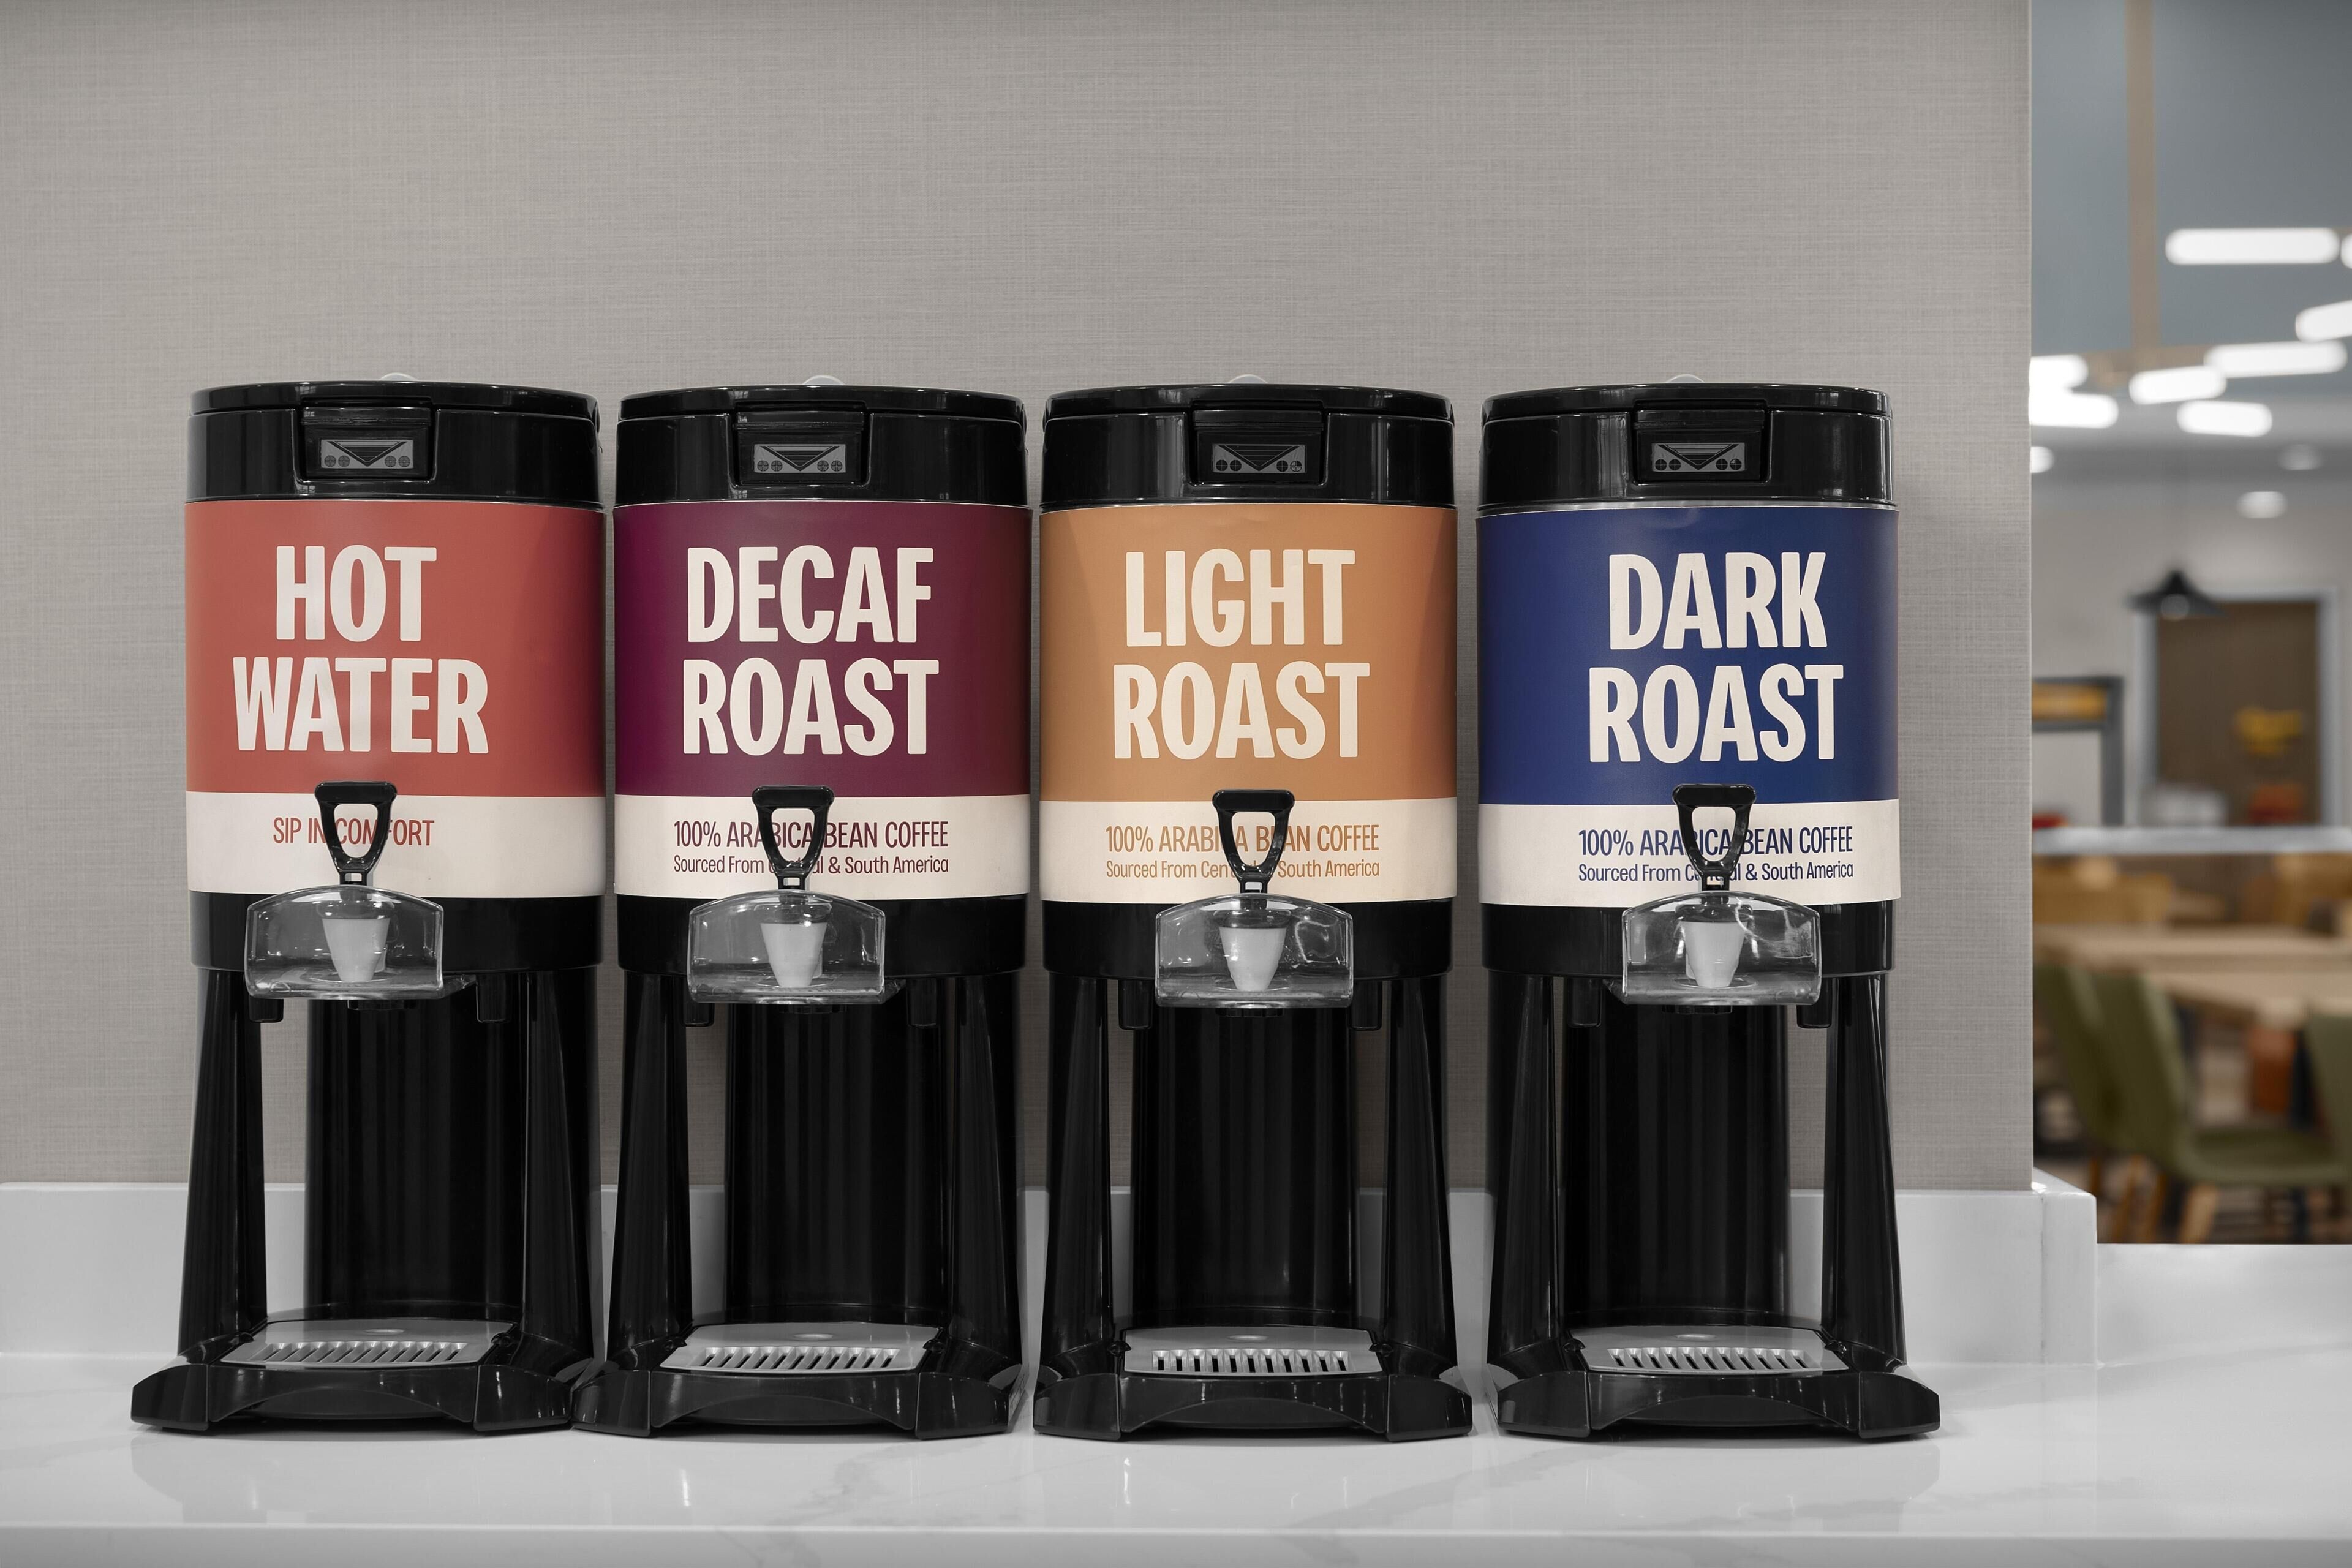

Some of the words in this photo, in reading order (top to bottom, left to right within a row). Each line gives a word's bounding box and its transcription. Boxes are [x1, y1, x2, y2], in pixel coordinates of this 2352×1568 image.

[276, 545, 437, 642] HOT
[687, 545, 933, 644] DECAF
[1126, 548, 1355, 647] LIGHT
[1609, 552, 1828, 649] DARK
[233, 657, 489, 753] WATER
[683, 657, 940, 756] ROAST
[1114, 661, 1370, 760] ROAST
[1589, 663, 1844, 763] ROAST
[273, 817, 302, 843] SIP
[335, 818, 435, 846] COMORT
[674, 821, 721, 847] 100%
[824, 821, 878, 848] BEAN
[885, 821, 949, 848] COFFEE
[674, 854, 725, 873] Sourced
[729, 856, 764, 873] From
[828, 856, 841, 874] &
[845, 856, 888, 873] South
[892, 855, 948, 873] America
[1106, 826, 1153, 852] 100%
[1159, 826, 1249, 852] ARABIA
[1256, 826, 1310, 852] BAN
[1317, 824, 1379, 851] COFFEE
[1106, 860, 1157, 878] Sourced
[1161, 861, 1197, 878] From
[1278, 859, 1321, 878] South
[1325, 859, 1379, 877] America
[1578, 829, 1634, 856] 100%
[1741, 827, 1793, 855] BEAN
[1799, 826, 1853, 853] COFFEE
[1578, 864, 1638, 881] Sourced
[1642, 864, 1681, 881] From
[1745, 863, 1757, 881] &
[1762, 862, 1803, 880] South
[1807, 861, 1853, 879] America
